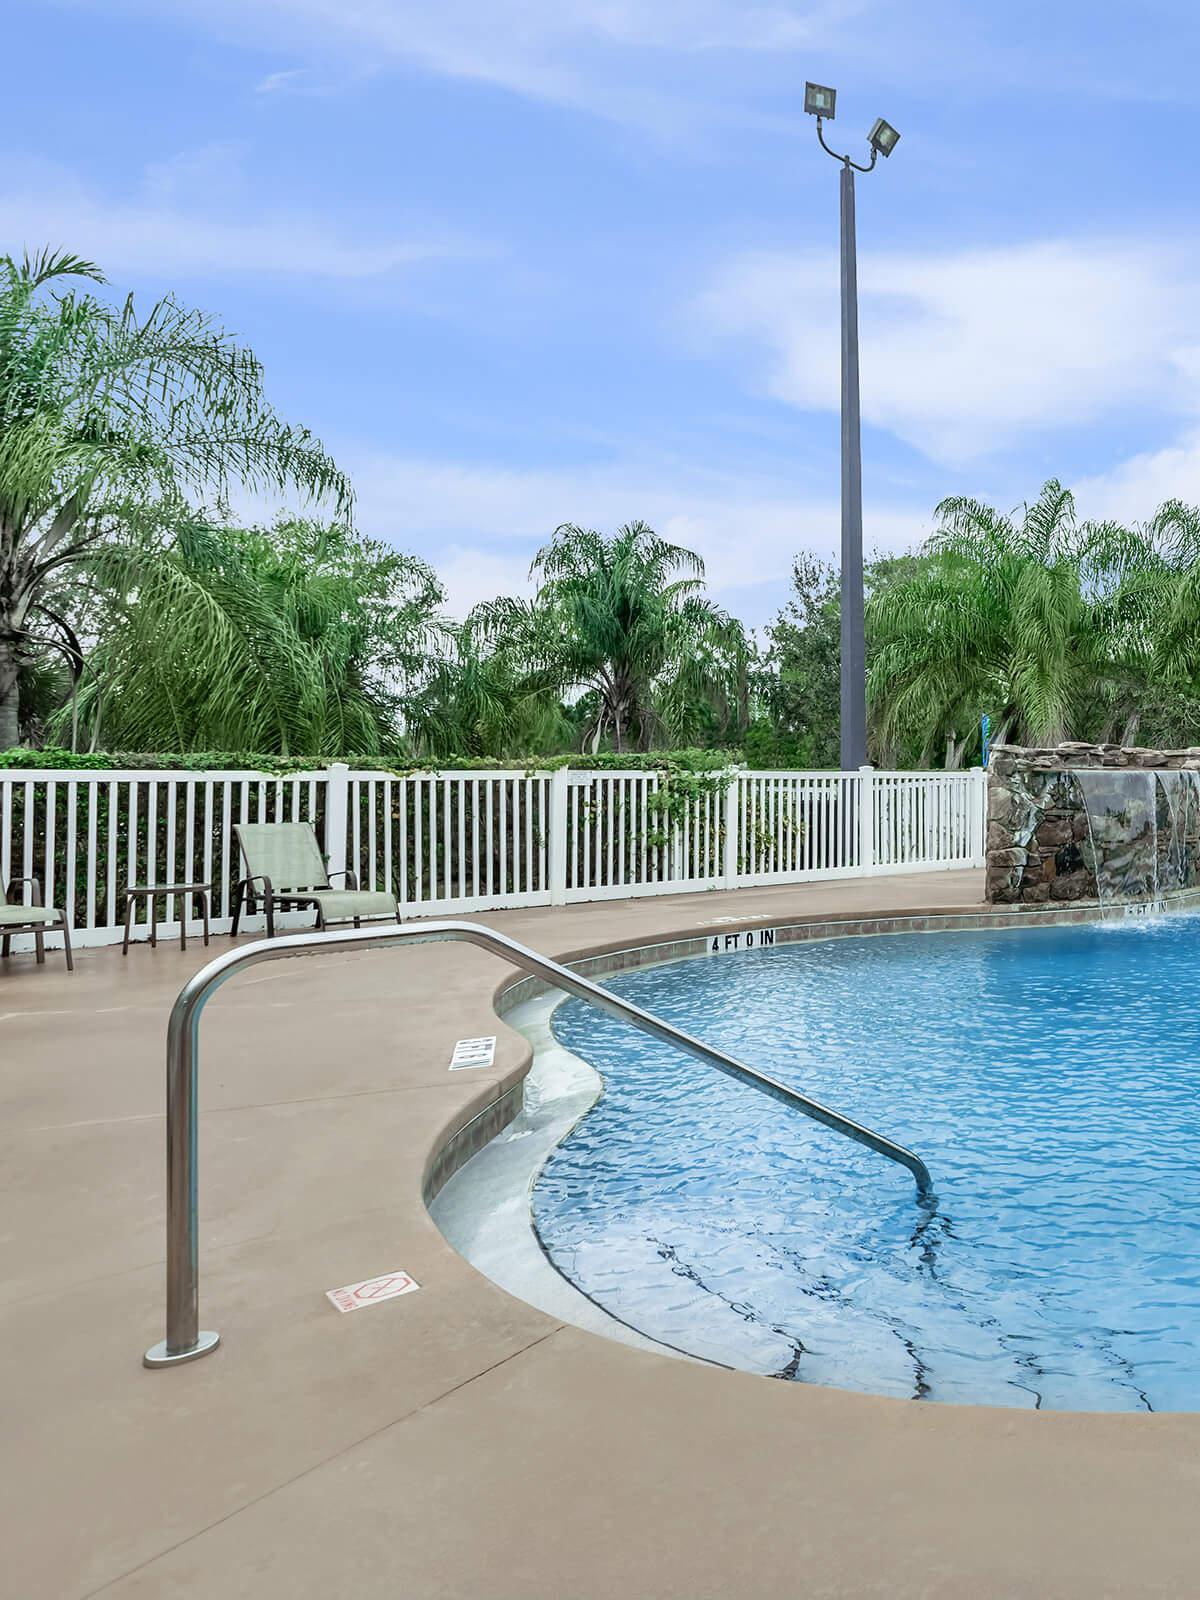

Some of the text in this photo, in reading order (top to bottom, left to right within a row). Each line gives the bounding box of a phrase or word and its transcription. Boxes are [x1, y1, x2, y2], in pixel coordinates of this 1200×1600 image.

[712, 929, 774, 951] 4 FT 0 IN
